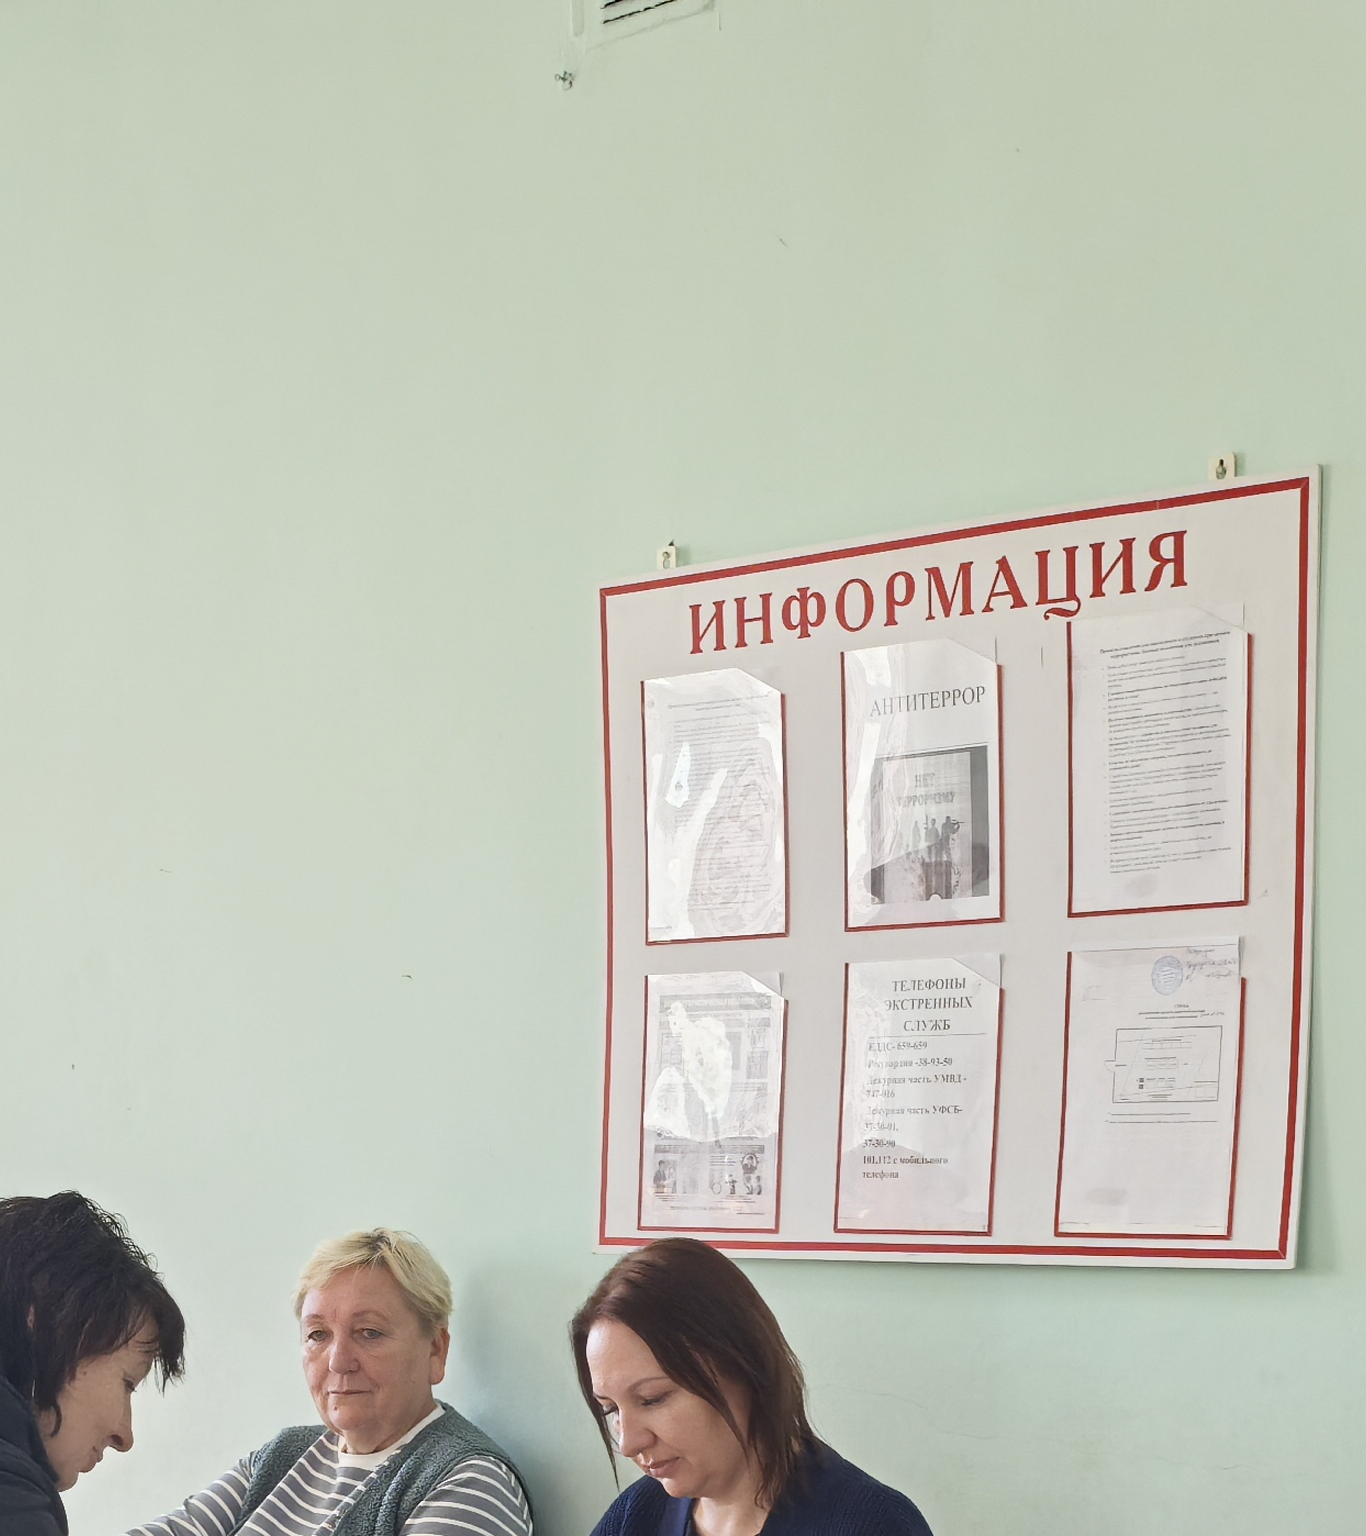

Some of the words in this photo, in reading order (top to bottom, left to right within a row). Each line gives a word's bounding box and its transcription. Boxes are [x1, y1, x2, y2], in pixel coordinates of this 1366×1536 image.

[690, 530, 1187, 654] ИНФОРМАЦИЯ
[870, 685, 986, 717] АНТИТЕРРОР
[914, 772, 936, 789] НЕТ
[892, 978, 966, 992] ТЕЛЕФОНЫ
[885, 996, 973, 1011] ЭКСТРЕННЫХ
[903, 1019, 951, 1031] СЛУЖБ
[934, 1074, 961, 1083] УМВД
[907, 1107, 929, 1115] часть
[899, 1156, 948, 1165] мобильного
[862, 1170, 899, 1180] телефона
